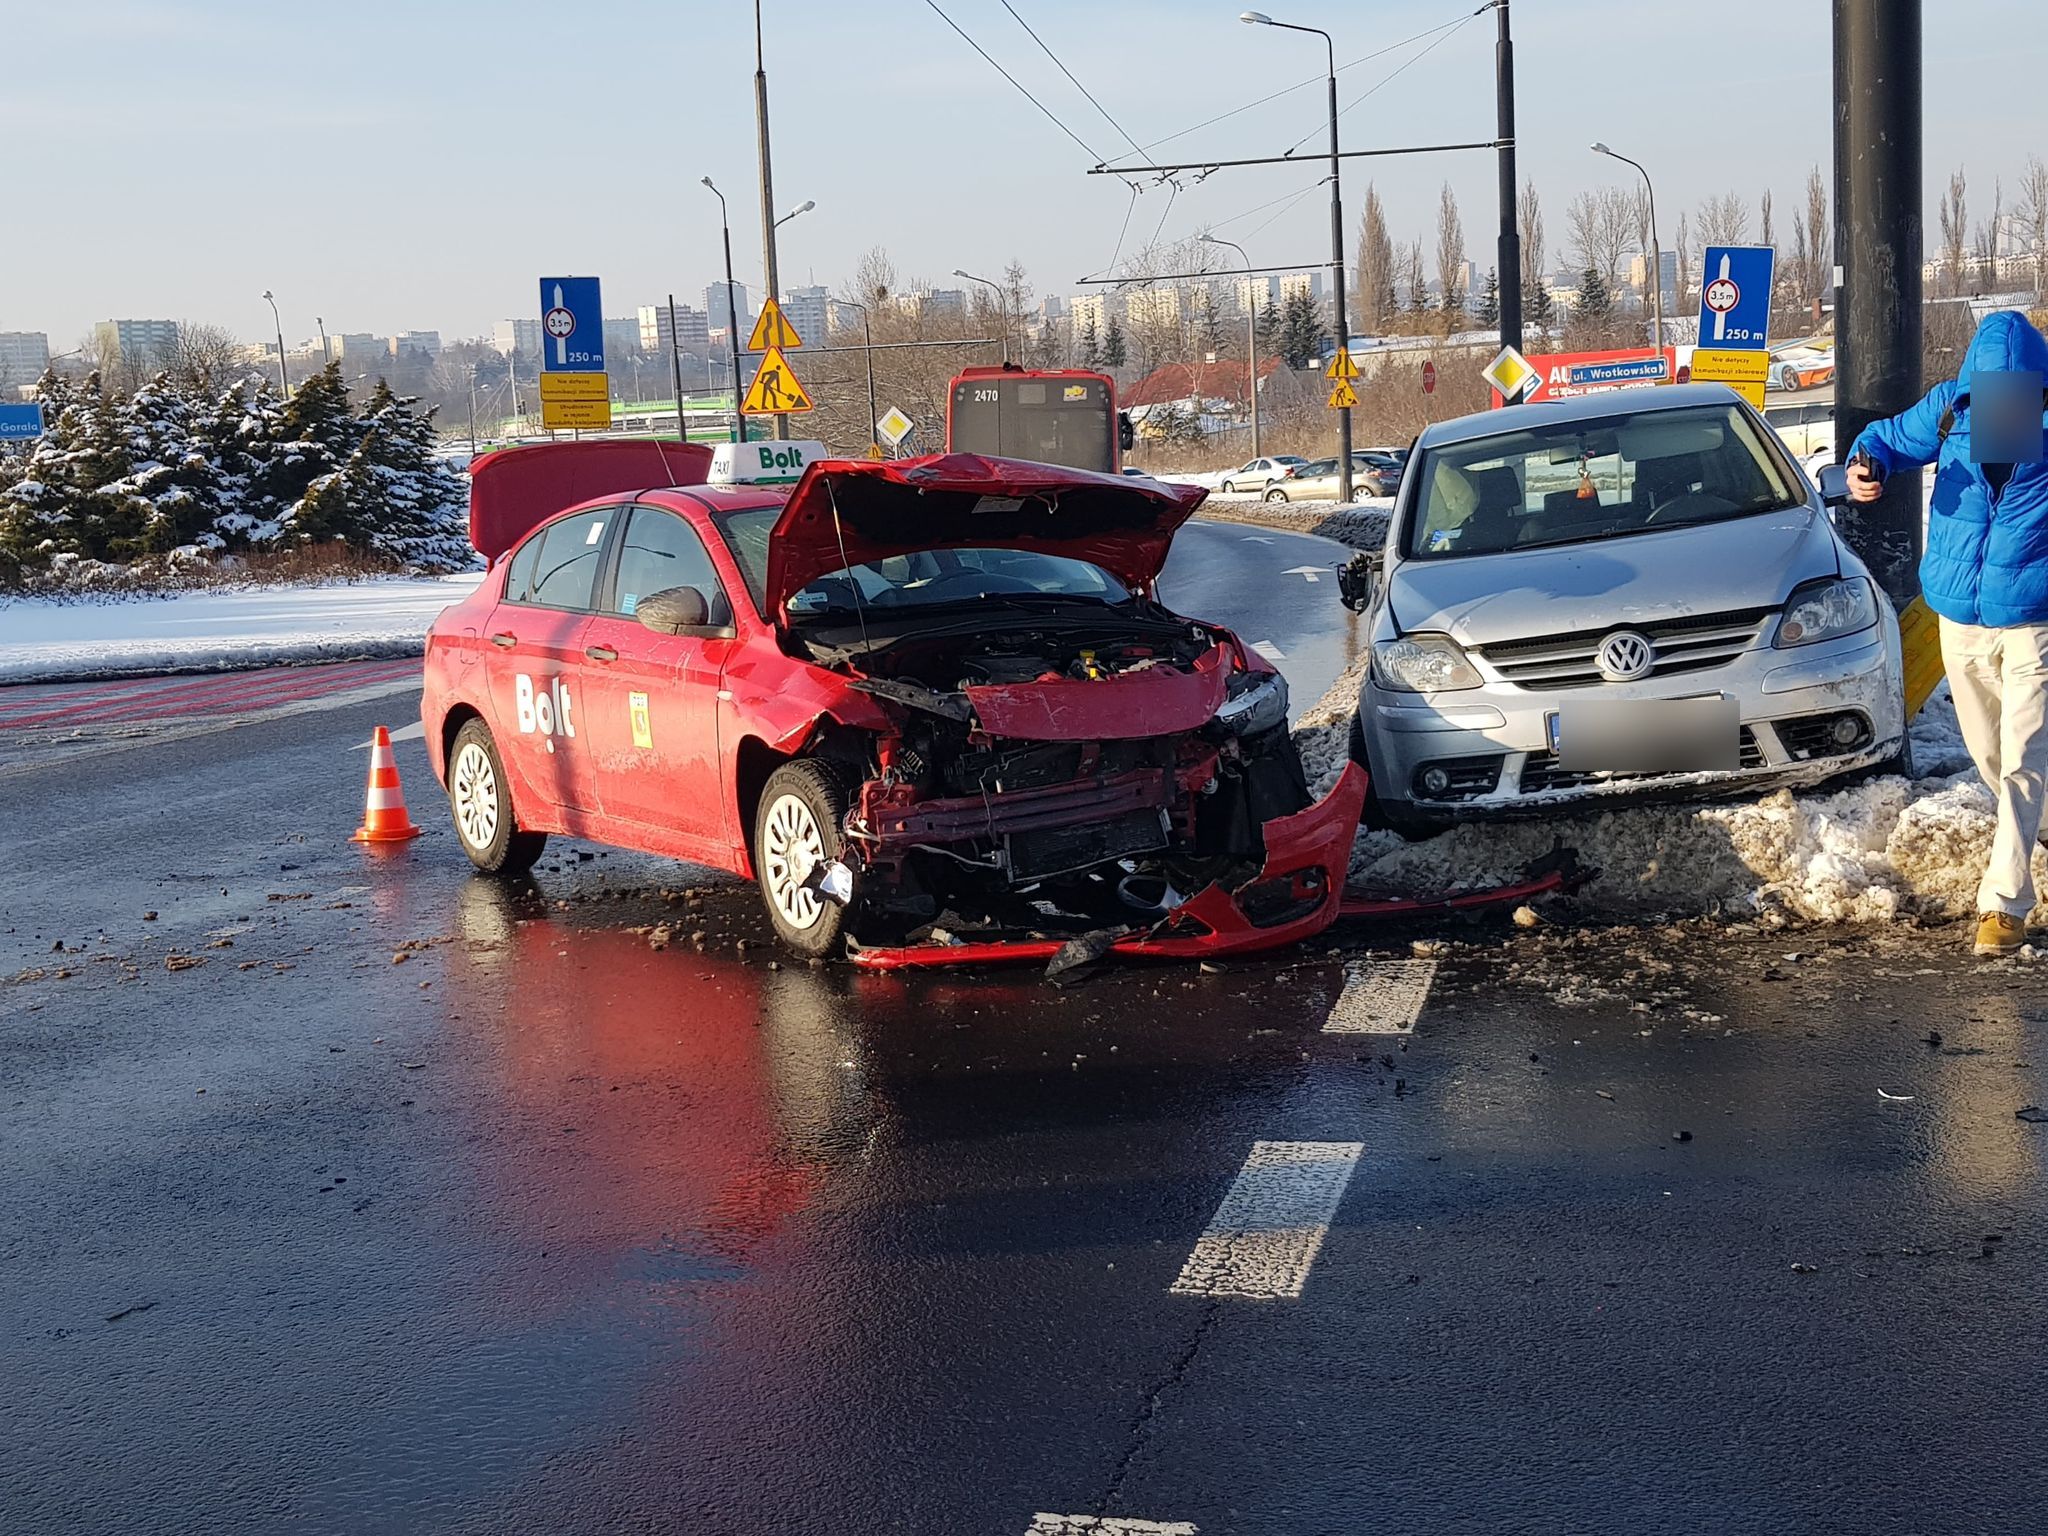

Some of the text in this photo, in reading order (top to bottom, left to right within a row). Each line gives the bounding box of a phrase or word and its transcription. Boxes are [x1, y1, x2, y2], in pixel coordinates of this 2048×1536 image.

[1710, 290, 1725, 301] 3,5
[1725, 329, 1763, 340] 250 m
[568, 352, 602, 362] 250 m
[1573, 365, 1658, 381] ul. Wrotkowska
[974, 390, 998, 402] 2470
[758, 447, 803, 469] Bolt
[713, 461, 730, 475] TAXI
[515, 673, 576, 738] Bolt
